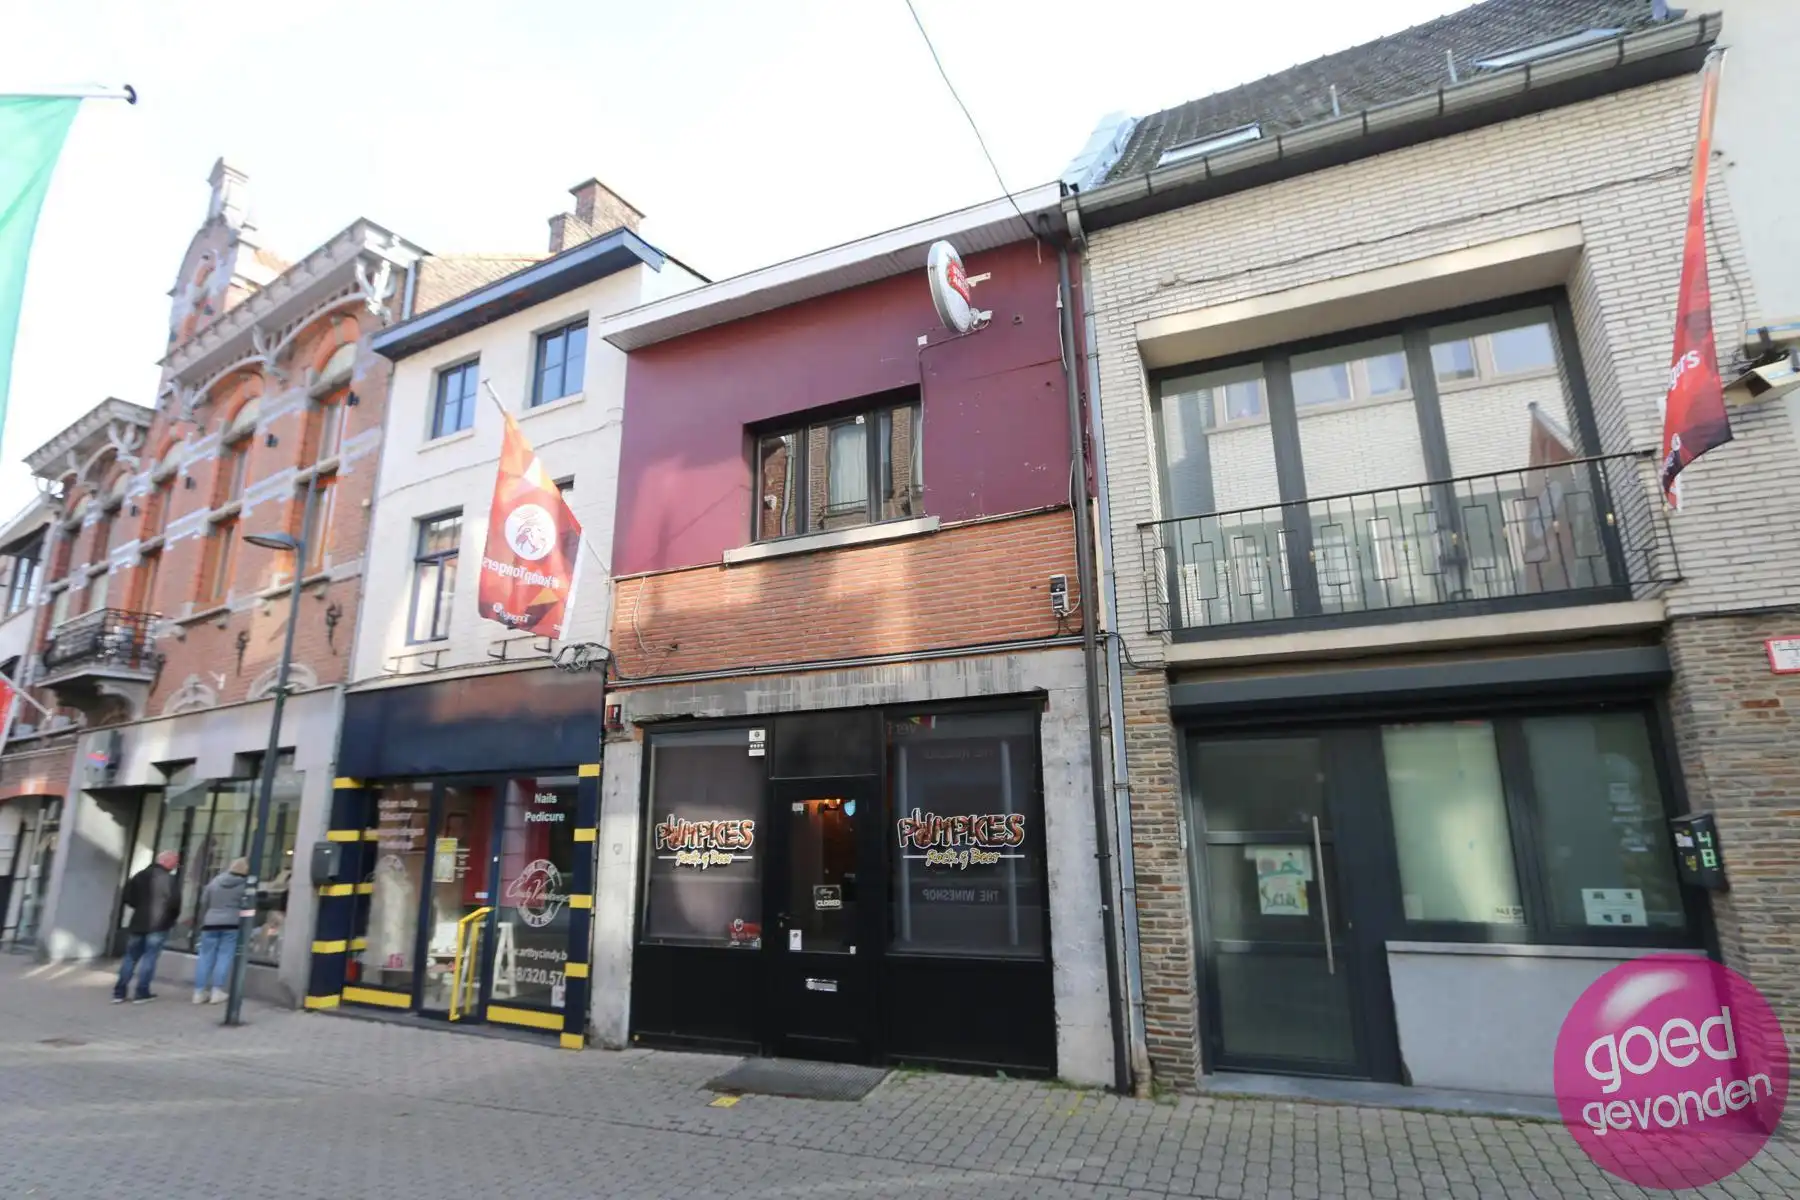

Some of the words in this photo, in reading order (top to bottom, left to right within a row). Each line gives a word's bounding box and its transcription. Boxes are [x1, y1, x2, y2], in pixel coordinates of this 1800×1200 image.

[534, 792, 558, 804] Nails
[524, 811, 566, 822] Pedicure
[897, 807, 1025, 849] PUMPKES
[969, 848, 1001, 864] Beer
